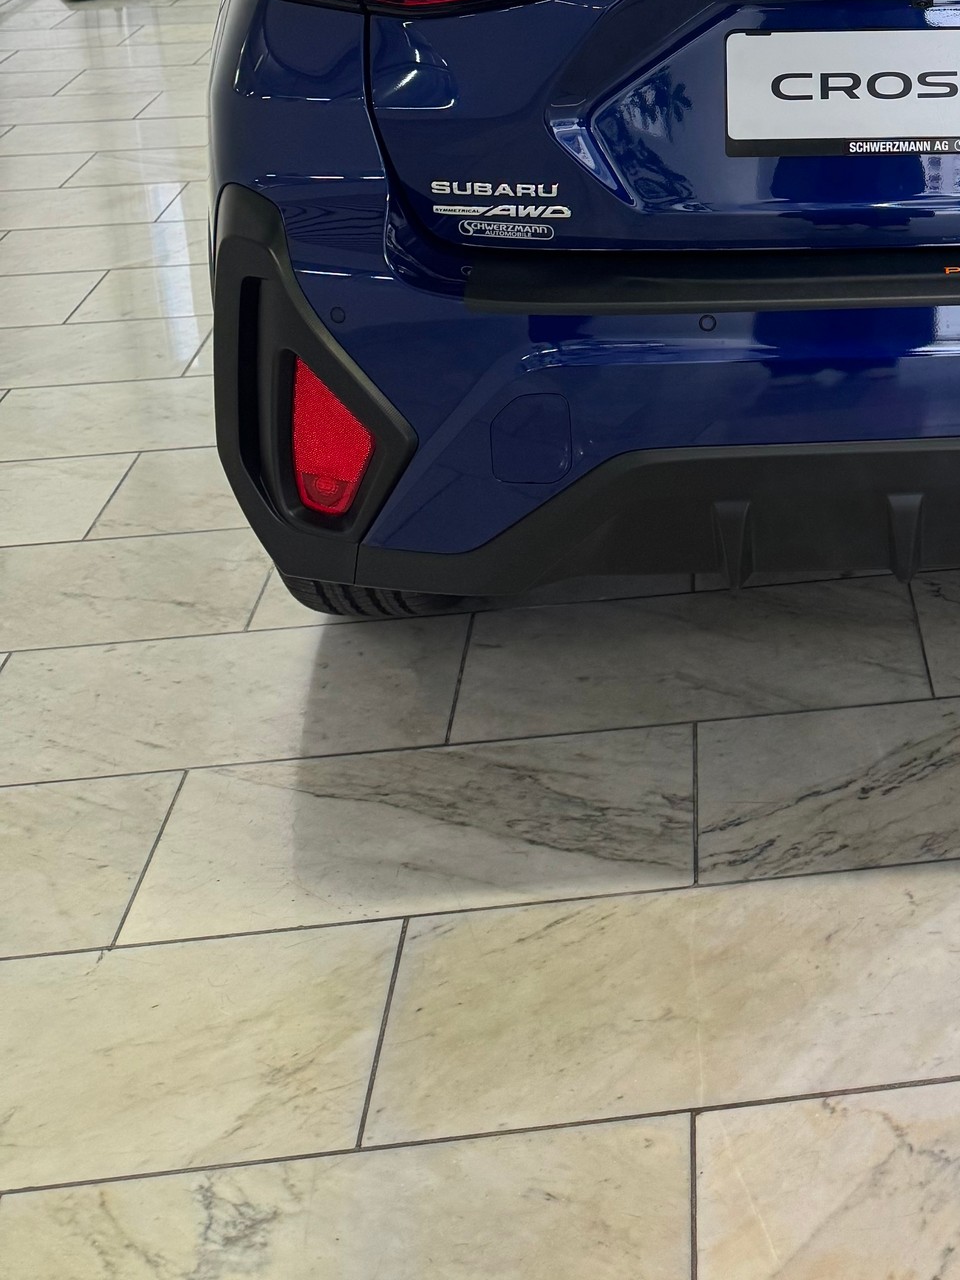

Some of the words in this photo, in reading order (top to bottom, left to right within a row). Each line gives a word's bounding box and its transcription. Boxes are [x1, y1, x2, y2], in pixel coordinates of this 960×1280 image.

[849, 141, 931, 152] SCHWERZMANN
[934, 140, 949, 151] AG
[431, 181, 559, 197] SUBARU
[484, 205, 571, 218] AWD
[464, 220, 547, 235] SCHWERZMANN
[485, 230, 532, 238] AUTOMOBILE
